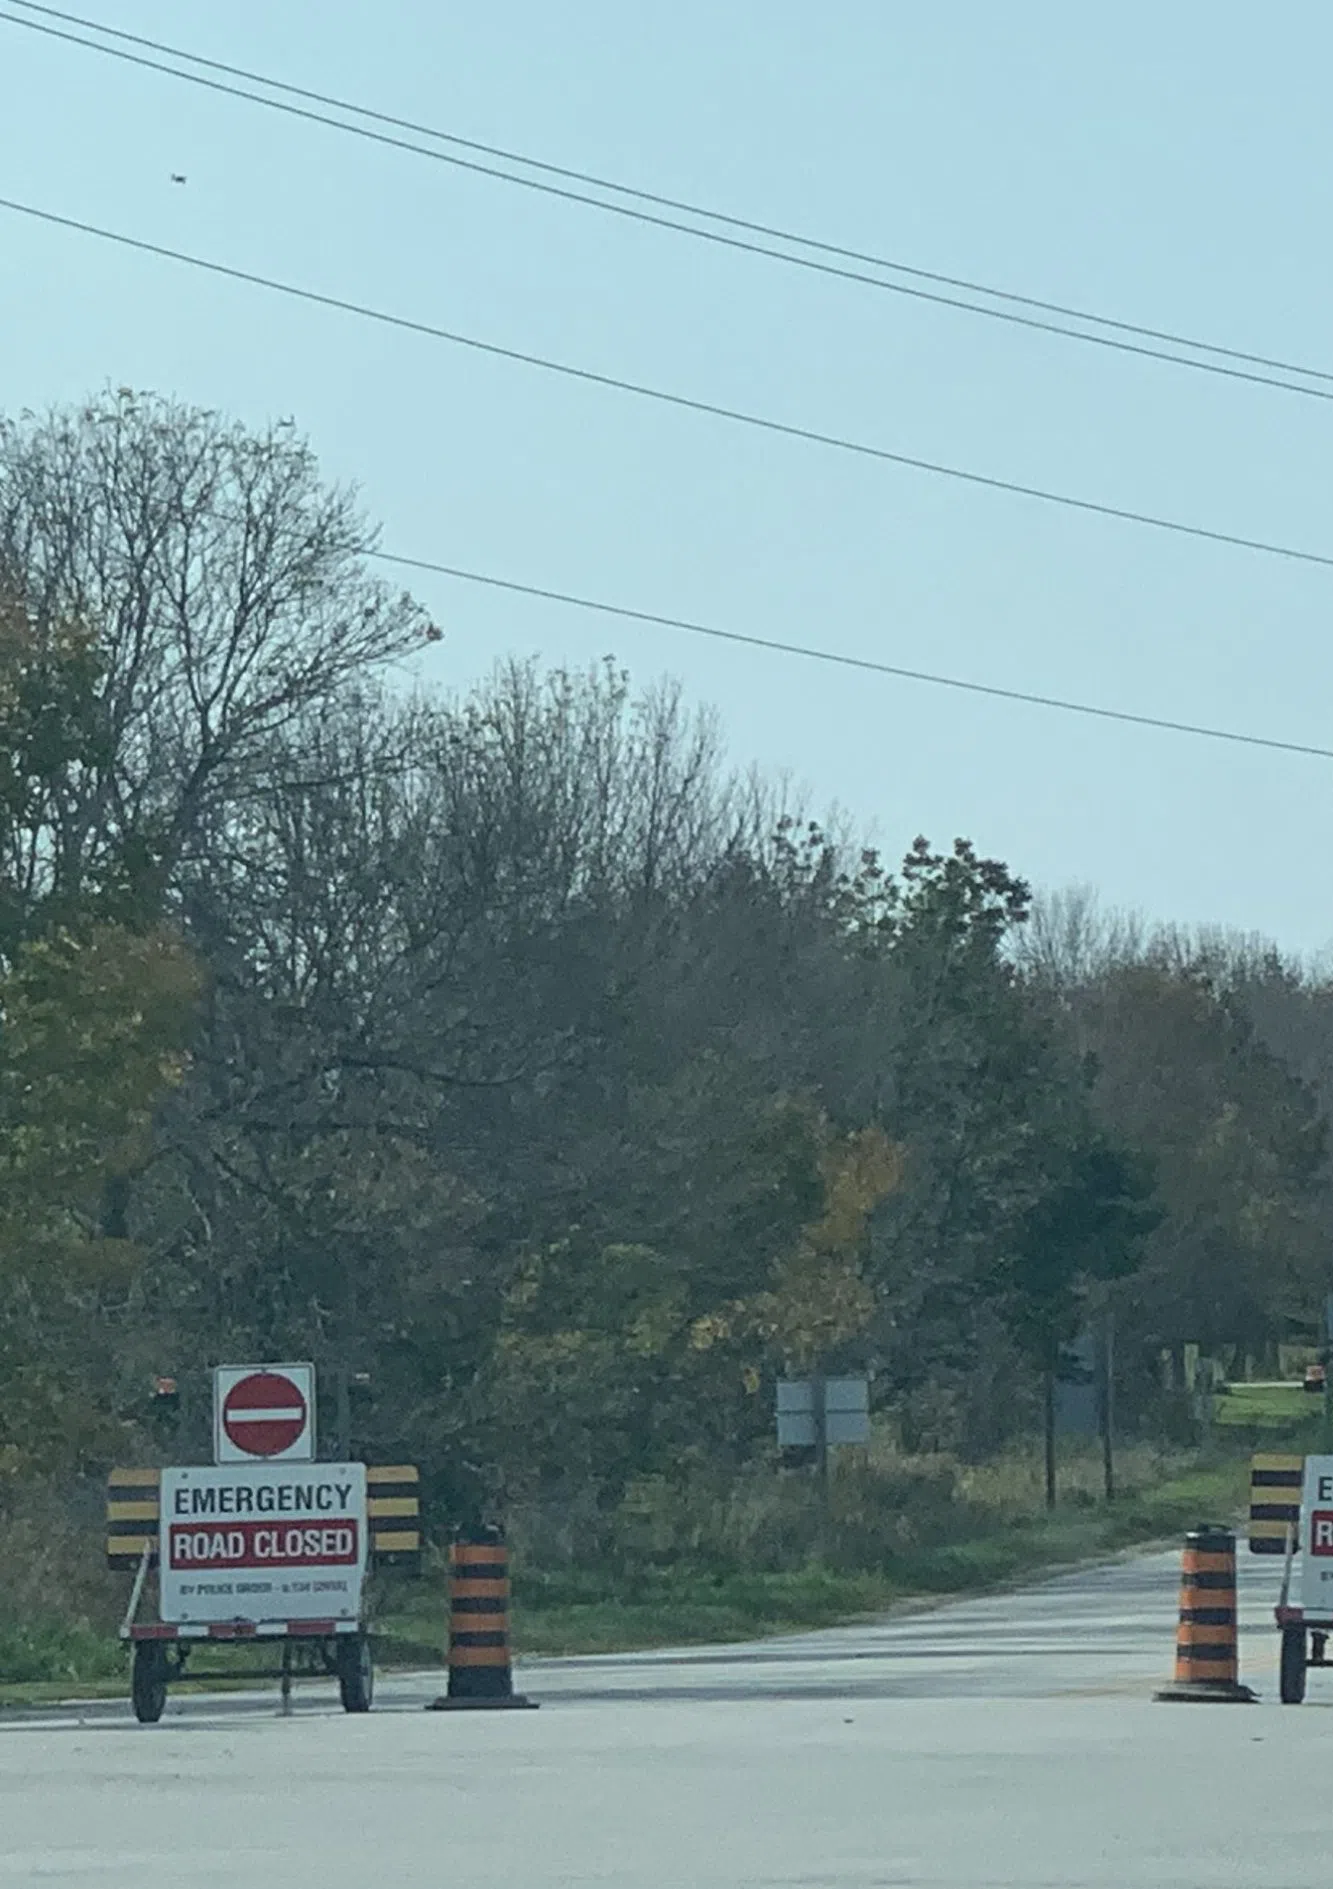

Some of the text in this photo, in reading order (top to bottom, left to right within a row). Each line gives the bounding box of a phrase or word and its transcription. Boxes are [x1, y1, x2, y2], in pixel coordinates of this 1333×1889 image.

[174, 1484, 352, 1514] EMERGENCY
[174, 1529, 353, 1560] ROAD CLOSED
